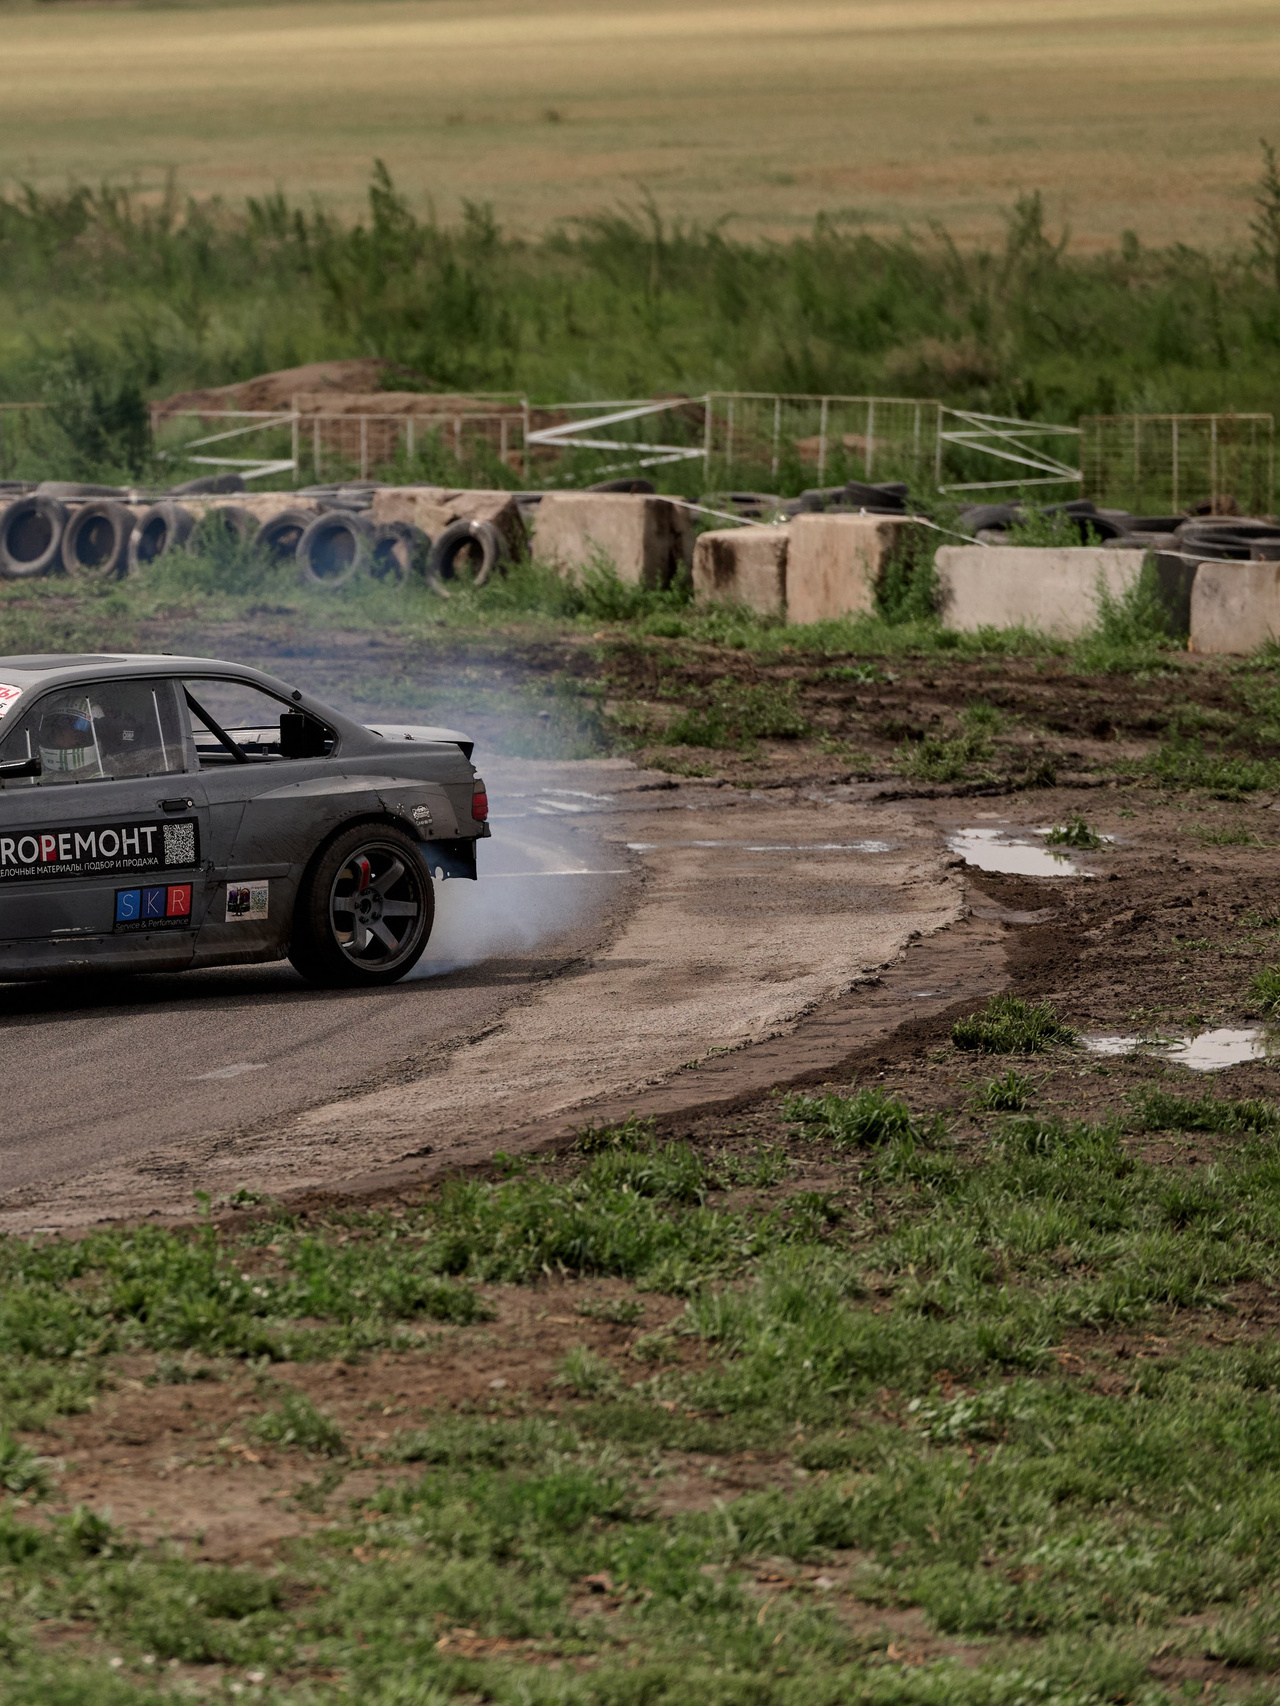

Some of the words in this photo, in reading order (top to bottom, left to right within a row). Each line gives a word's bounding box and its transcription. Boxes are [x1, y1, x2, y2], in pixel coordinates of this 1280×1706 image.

[84, 860, 115, 871] ПОДБОР
[116, 860, 122, 868] И
[123, 857, 159, 868] ПРОДАЖА
[116, 922, 140, 931] Service
[141, 920, 147, 928] &
